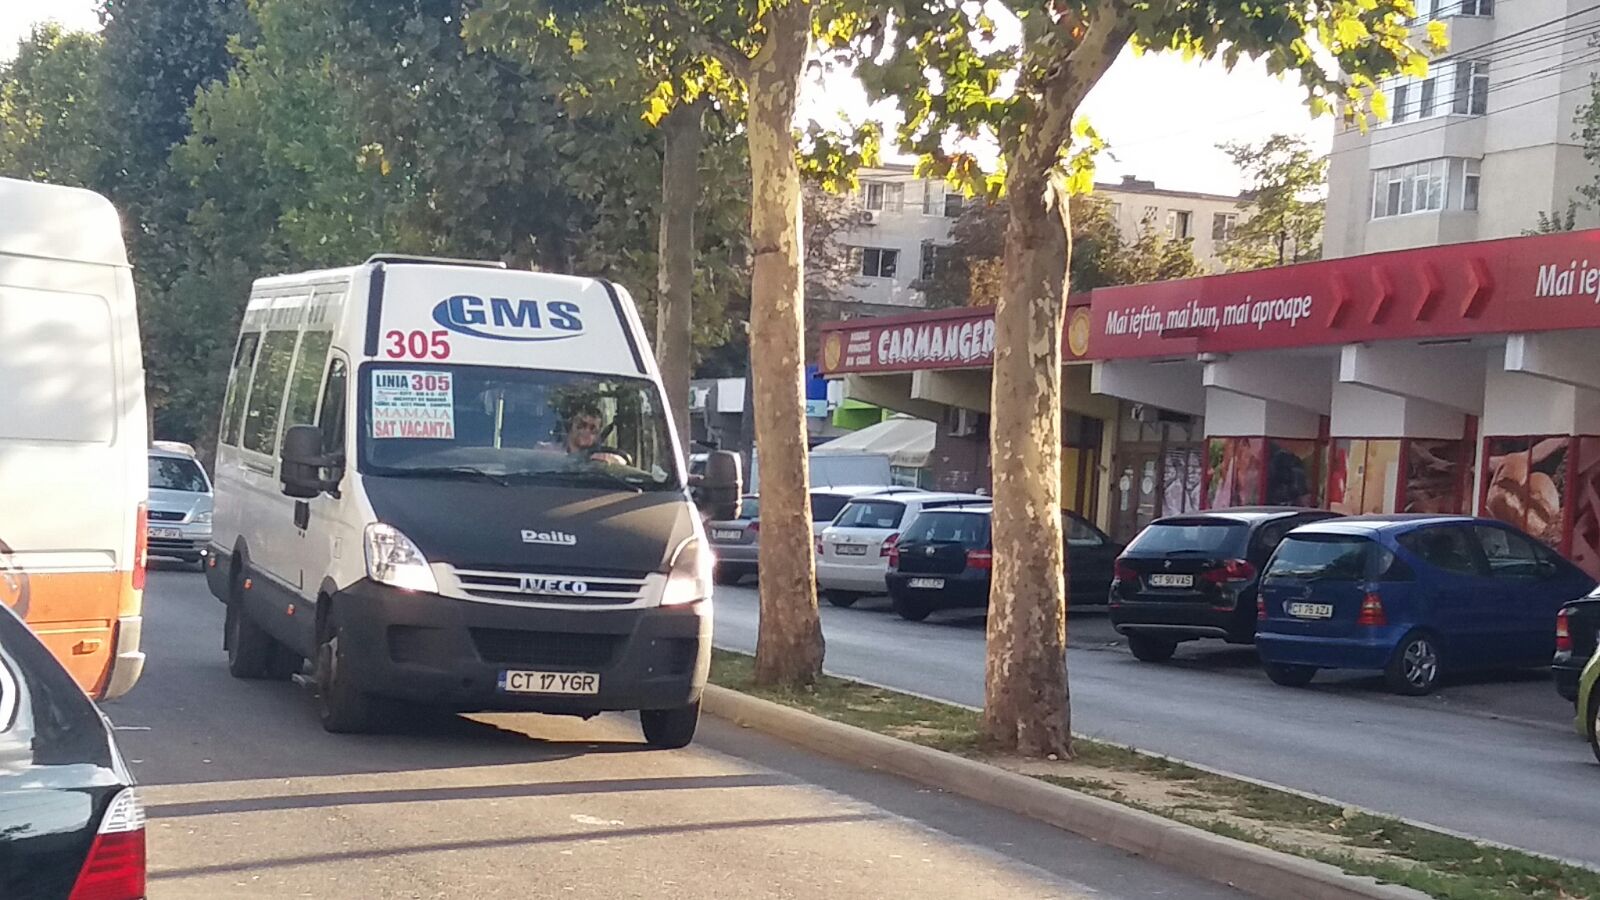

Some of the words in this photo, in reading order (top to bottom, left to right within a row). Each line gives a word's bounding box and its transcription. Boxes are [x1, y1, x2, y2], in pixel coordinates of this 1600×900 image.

[1535, 260, 1577, 297] Mai
[449, 295, 583, 331] GMS
[1105, 308, 1130, 335] Mai
[1129, 305, 1164, 339] ieftin,
[1166, 301, 1192, 330] mai
[1191, 300, 1220, 333] bun,
[1222, 295, 1251, 326] mai
[1251, 295, 1312, 330] aproape
[386, 330, 451, 359] 305
[878, 319, 995, 365] CARMANGER
[376, 374, 409, 389] LINIA
[411, 374, 450, 391] 305
[375, 407, 451, 420] MAMAIA
[375, 420, 397, 437] SAT
[399, 420, 453, 438] VACANTA
[521, 529, 577, 546] Daily
[520, 577, 588, 595] IVECO
[1153, 575, 1163, 584] CT
[510, 673, 534, 689] CT
[540, 674, 556, 690] 17
[559, 674, 595, 692] YGR
